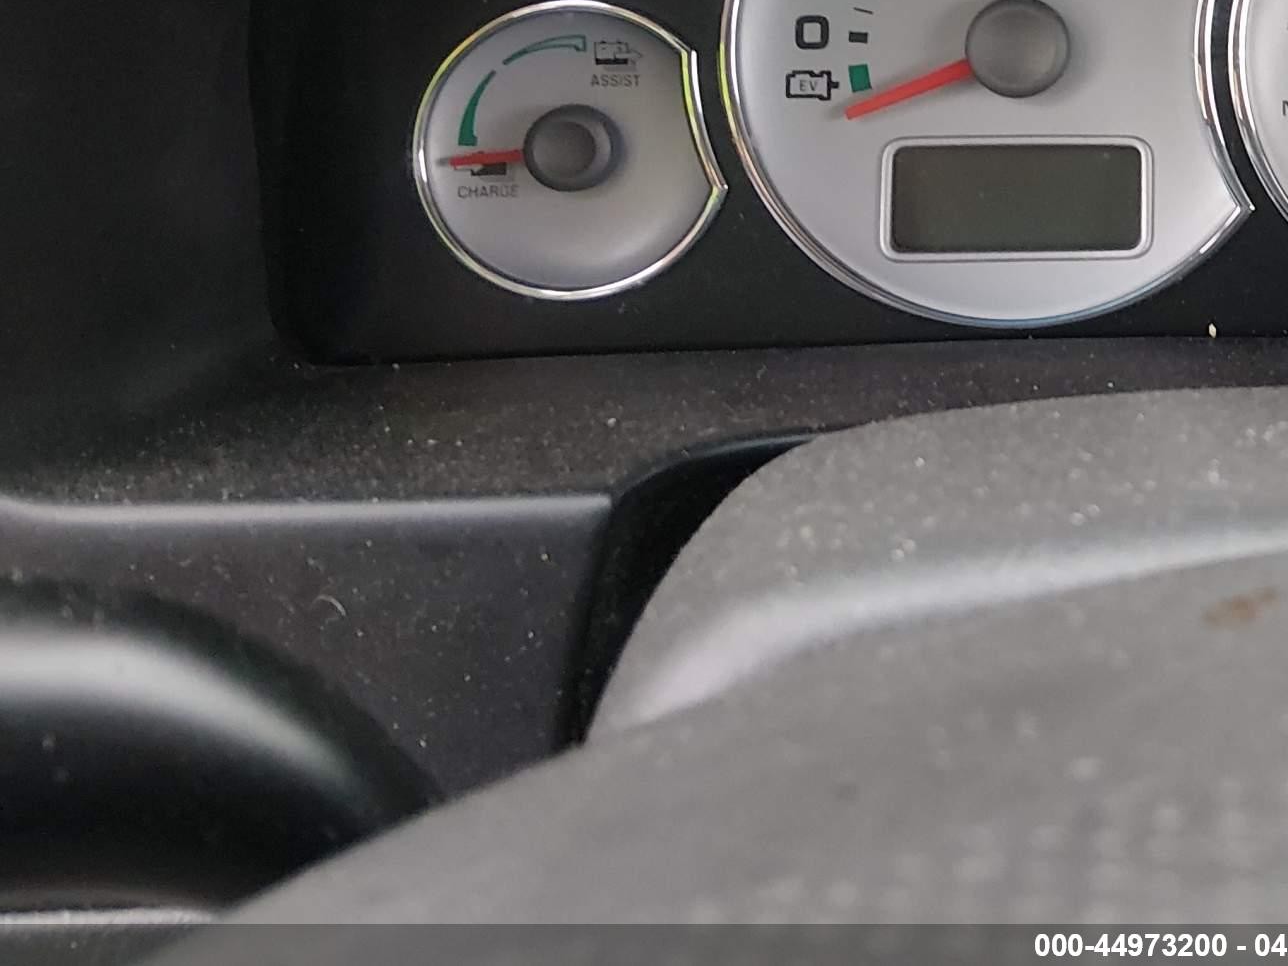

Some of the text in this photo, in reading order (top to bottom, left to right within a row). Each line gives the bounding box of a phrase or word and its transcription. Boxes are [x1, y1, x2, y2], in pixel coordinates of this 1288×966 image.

[795, 15, 829, 50] 0
[590, 74, 641, 88] ASSIST
[799, 79, 818, 92] EV
[457, 185, 519, 199] CHARGE
